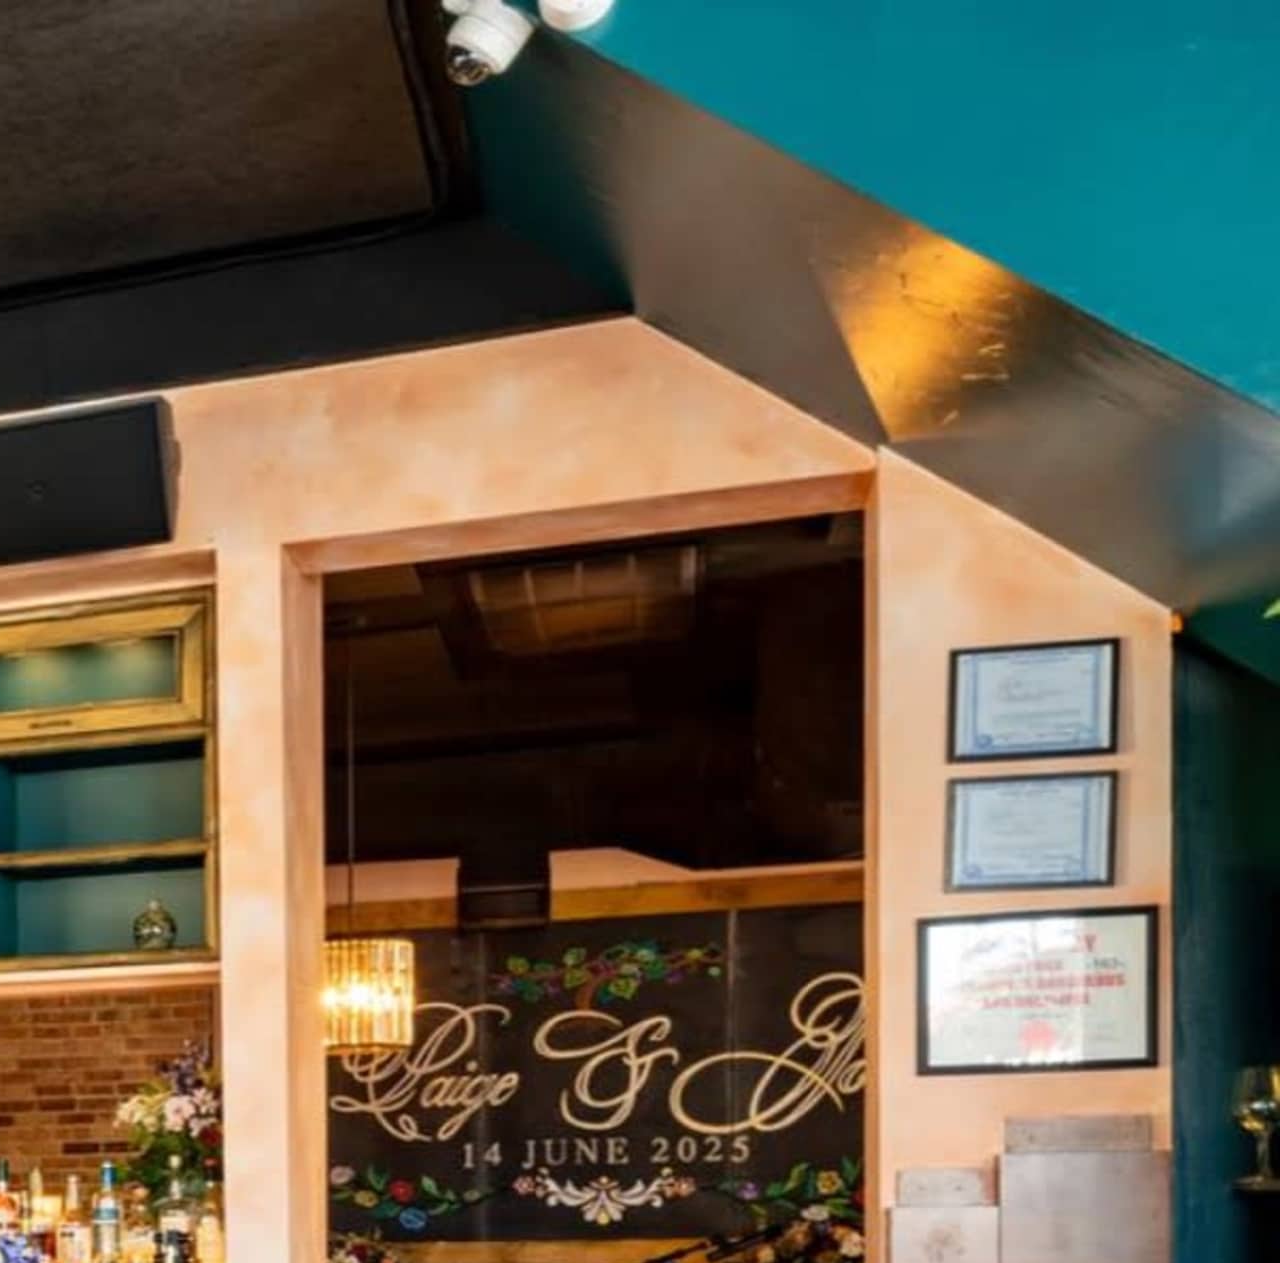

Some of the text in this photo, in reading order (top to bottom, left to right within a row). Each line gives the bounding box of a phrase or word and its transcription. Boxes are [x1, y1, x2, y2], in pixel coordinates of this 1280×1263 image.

[330, 1002, 520, 1142] Paige
[462, 1136, 752, 1169] 14 JUNE 2025
